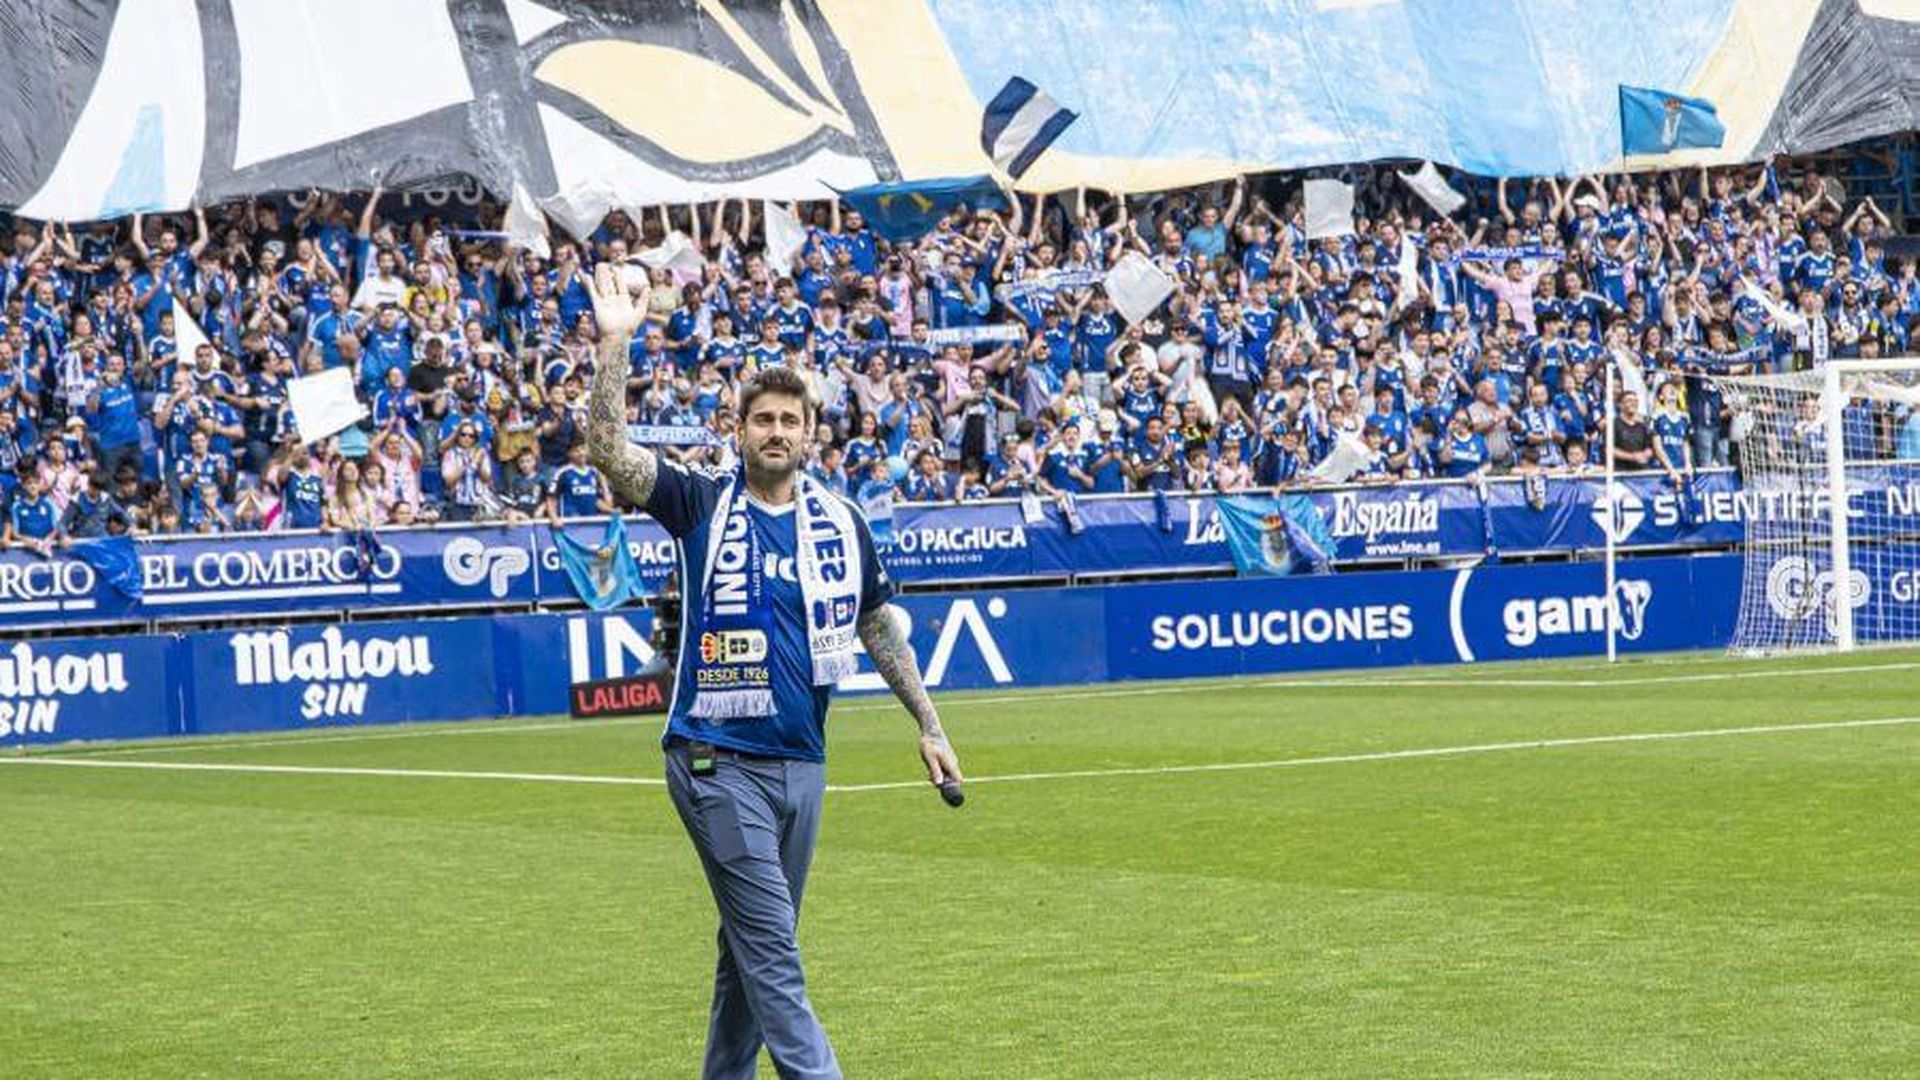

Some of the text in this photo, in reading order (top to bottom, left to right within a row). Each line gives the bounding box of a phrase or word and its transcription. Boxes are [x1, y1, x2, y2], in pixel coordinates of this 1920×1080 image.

[1331, 491, 1439, 543] España
[921, 525, 1027, 553] PACHUCA
[0, 561, 95, 599] RCIO
[142, 545, 401, 589] EL COMERCO
[1152, 605, 1413, 649] SOLUCIONES
[230, 626, 434, 684] Mahou
[301, 682, 368, 720] SIN
[578, 682, 662, 712] LALIGA
